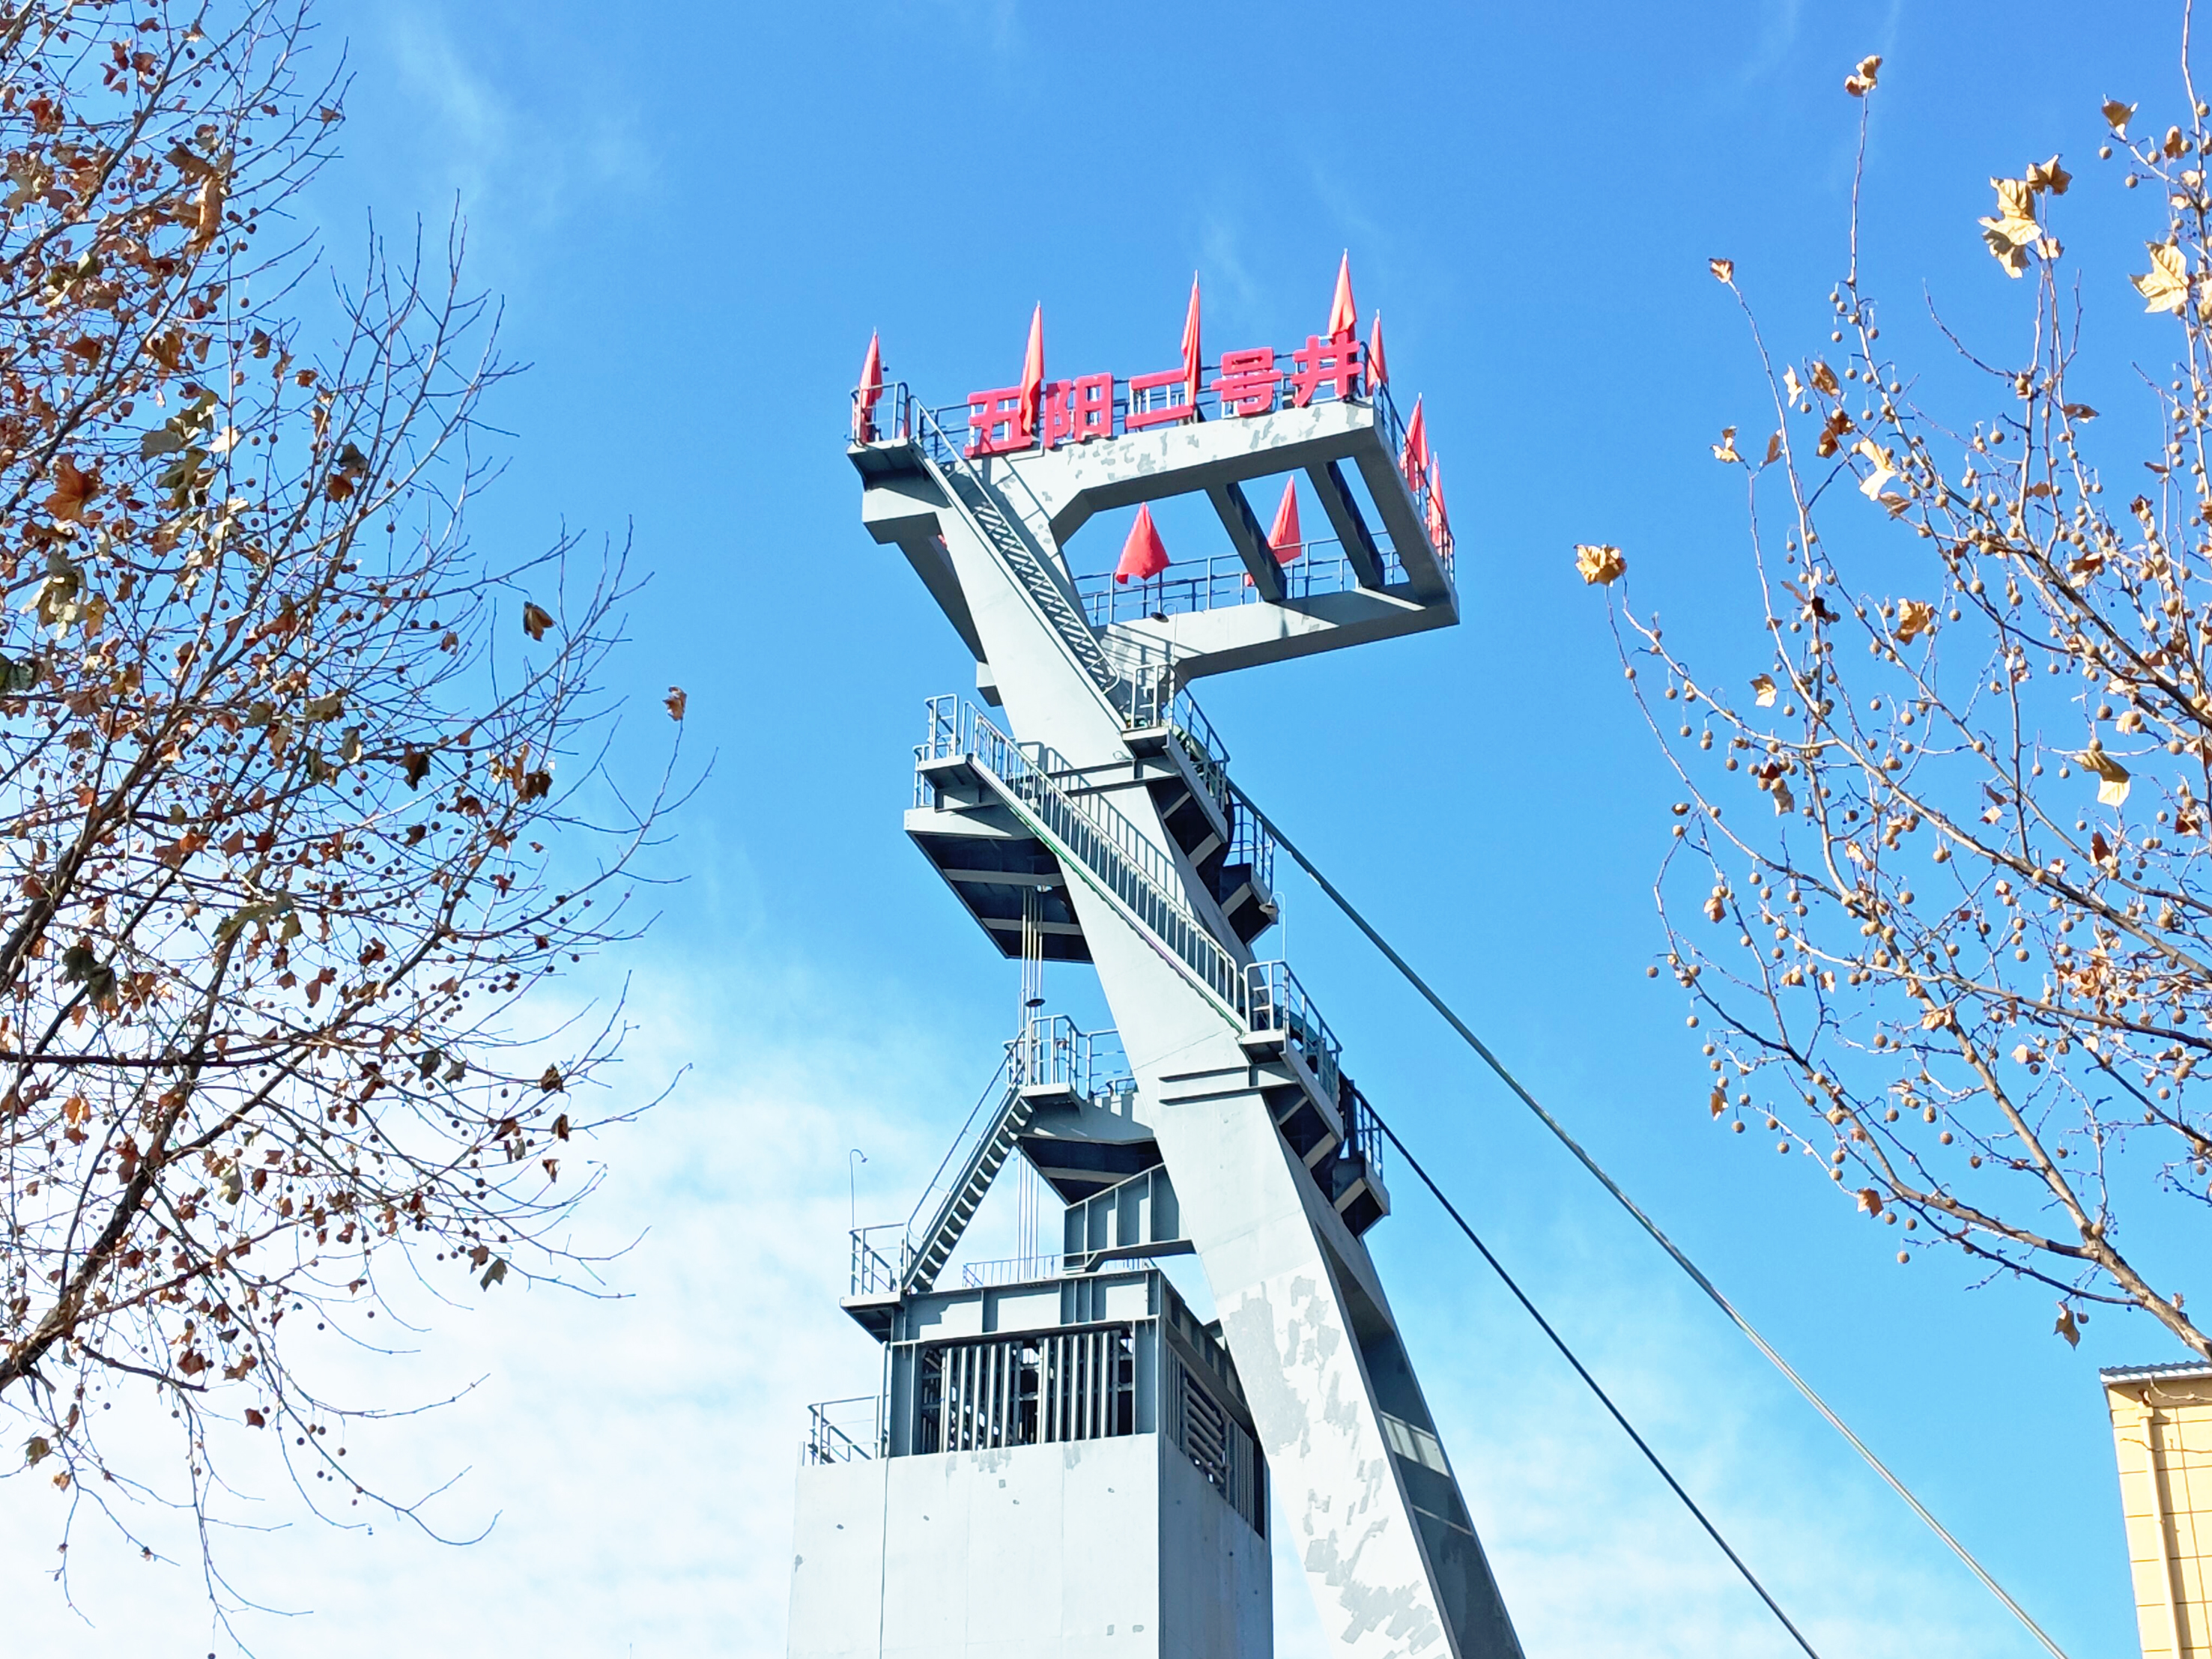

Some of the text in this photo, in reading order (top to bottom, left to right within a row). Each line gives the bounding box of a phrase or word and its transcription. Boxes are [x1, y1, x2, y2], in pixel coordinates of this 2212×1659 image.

[963, 332, 1363, 458] 五阳二号井
